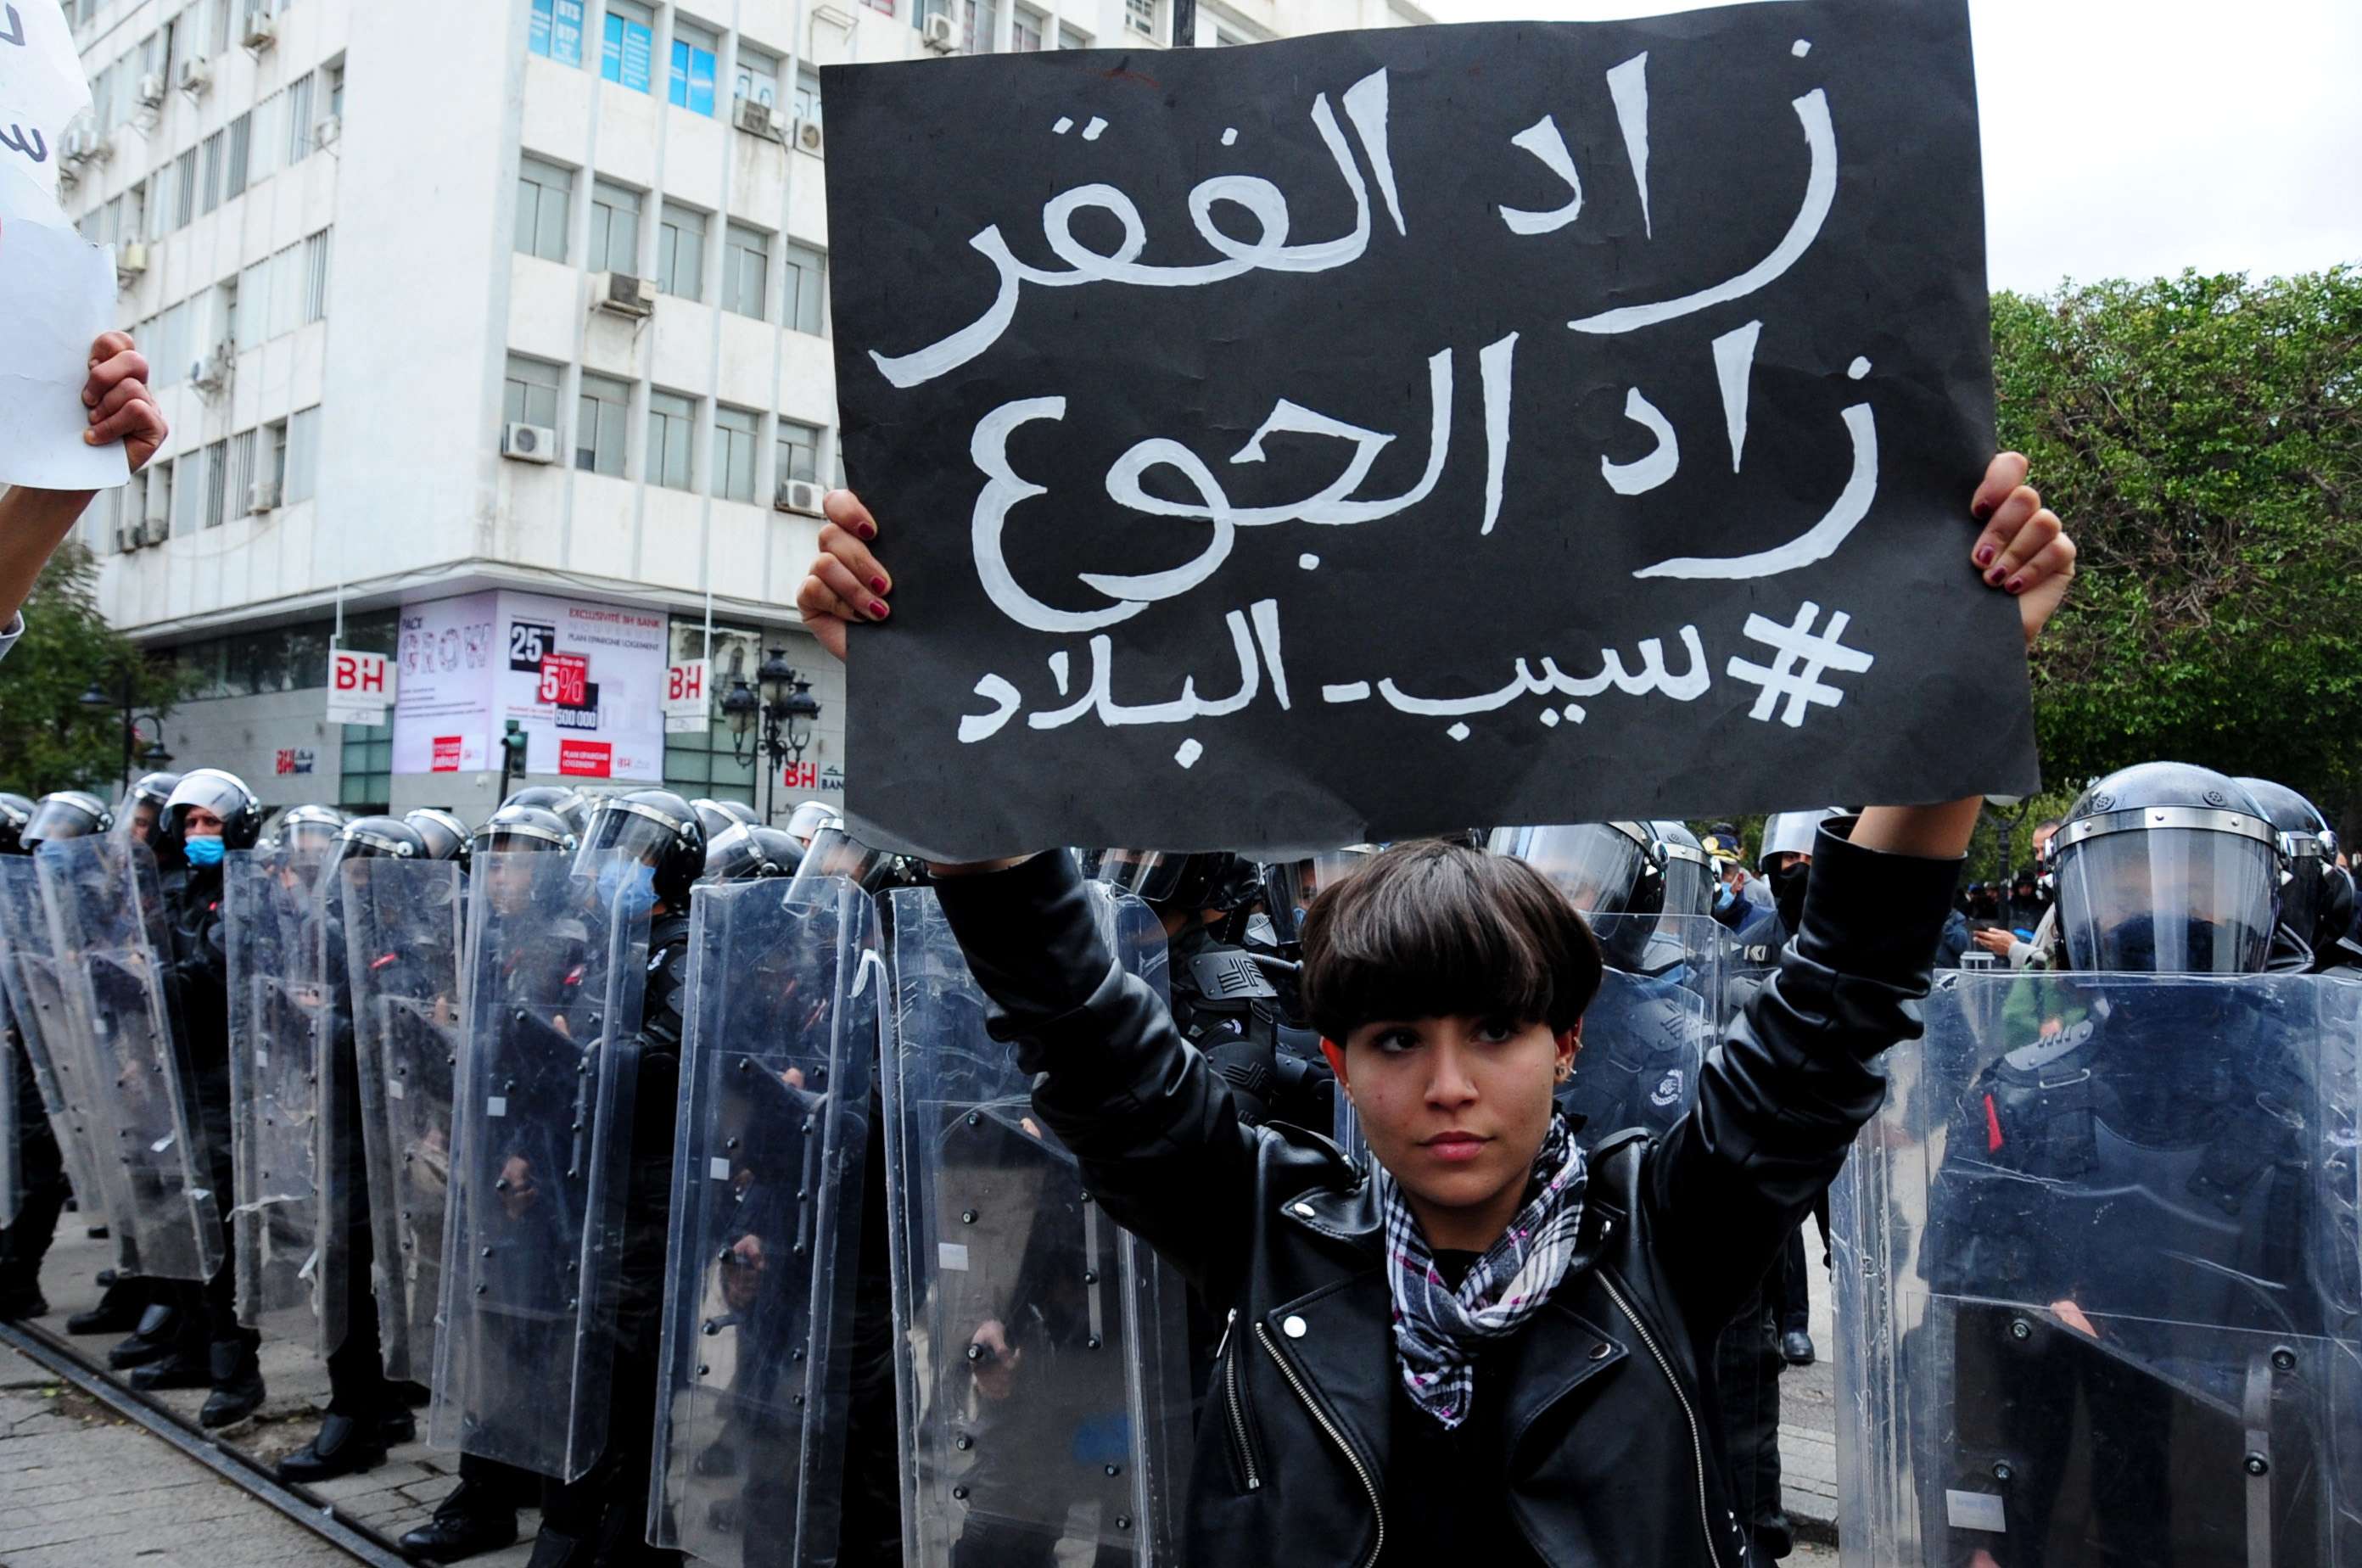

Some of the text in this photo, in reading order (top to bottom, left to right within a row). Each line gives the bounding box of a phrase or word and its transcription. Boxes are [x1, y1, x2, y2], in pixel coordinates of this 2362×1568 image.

[869, 38, 1837, 388] زاد الفقر
[971, 321, 1878, 632] زاد الجوع
[401, 623, 492, 676] GROW
[511, 624, 542, 663] 25
[337, 657, 383, 692] BH
[542, 665, 583, 703] 5%
[669, 664, 701, 700] BH
[277, 750, 294, 774] BH
[785, 760, 816, 788] BH
[821, 779, 844, 790] BAN
